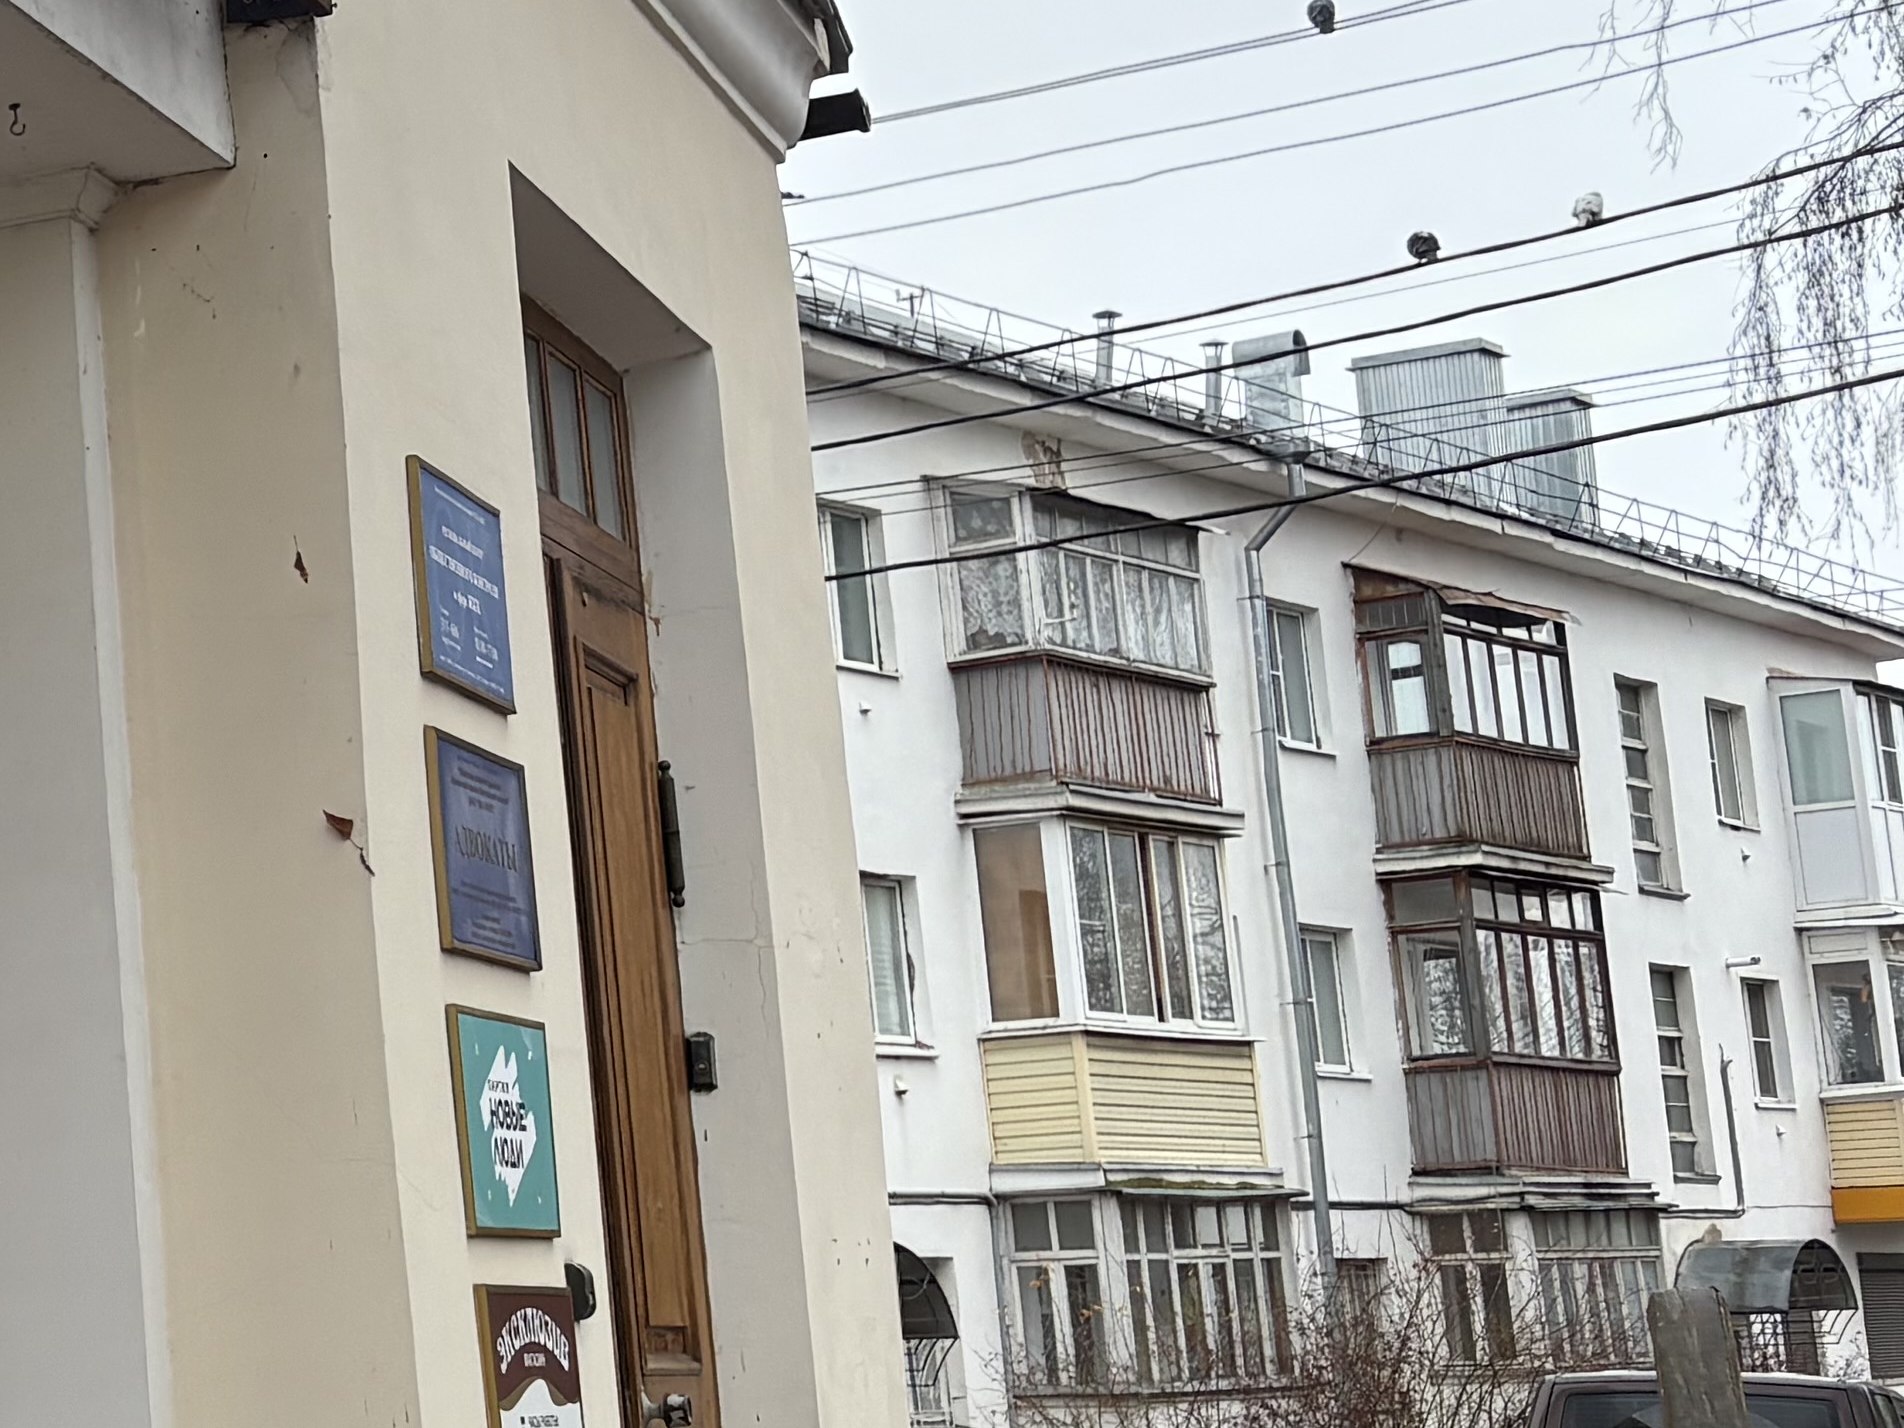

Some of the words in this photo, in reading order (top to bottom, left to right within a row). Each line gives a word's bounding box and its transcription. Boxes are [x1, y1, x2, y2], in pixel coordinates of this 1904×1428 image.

[455, 825, 518, 872] АДВОКАТЫ
[489, 1097, 527, 1132] НОВЫЕ
[494, 1136, 524, 1169] ЛЮДИ
[496, 1307, 570, 1374] ЭКСКЛЮЗИВ
